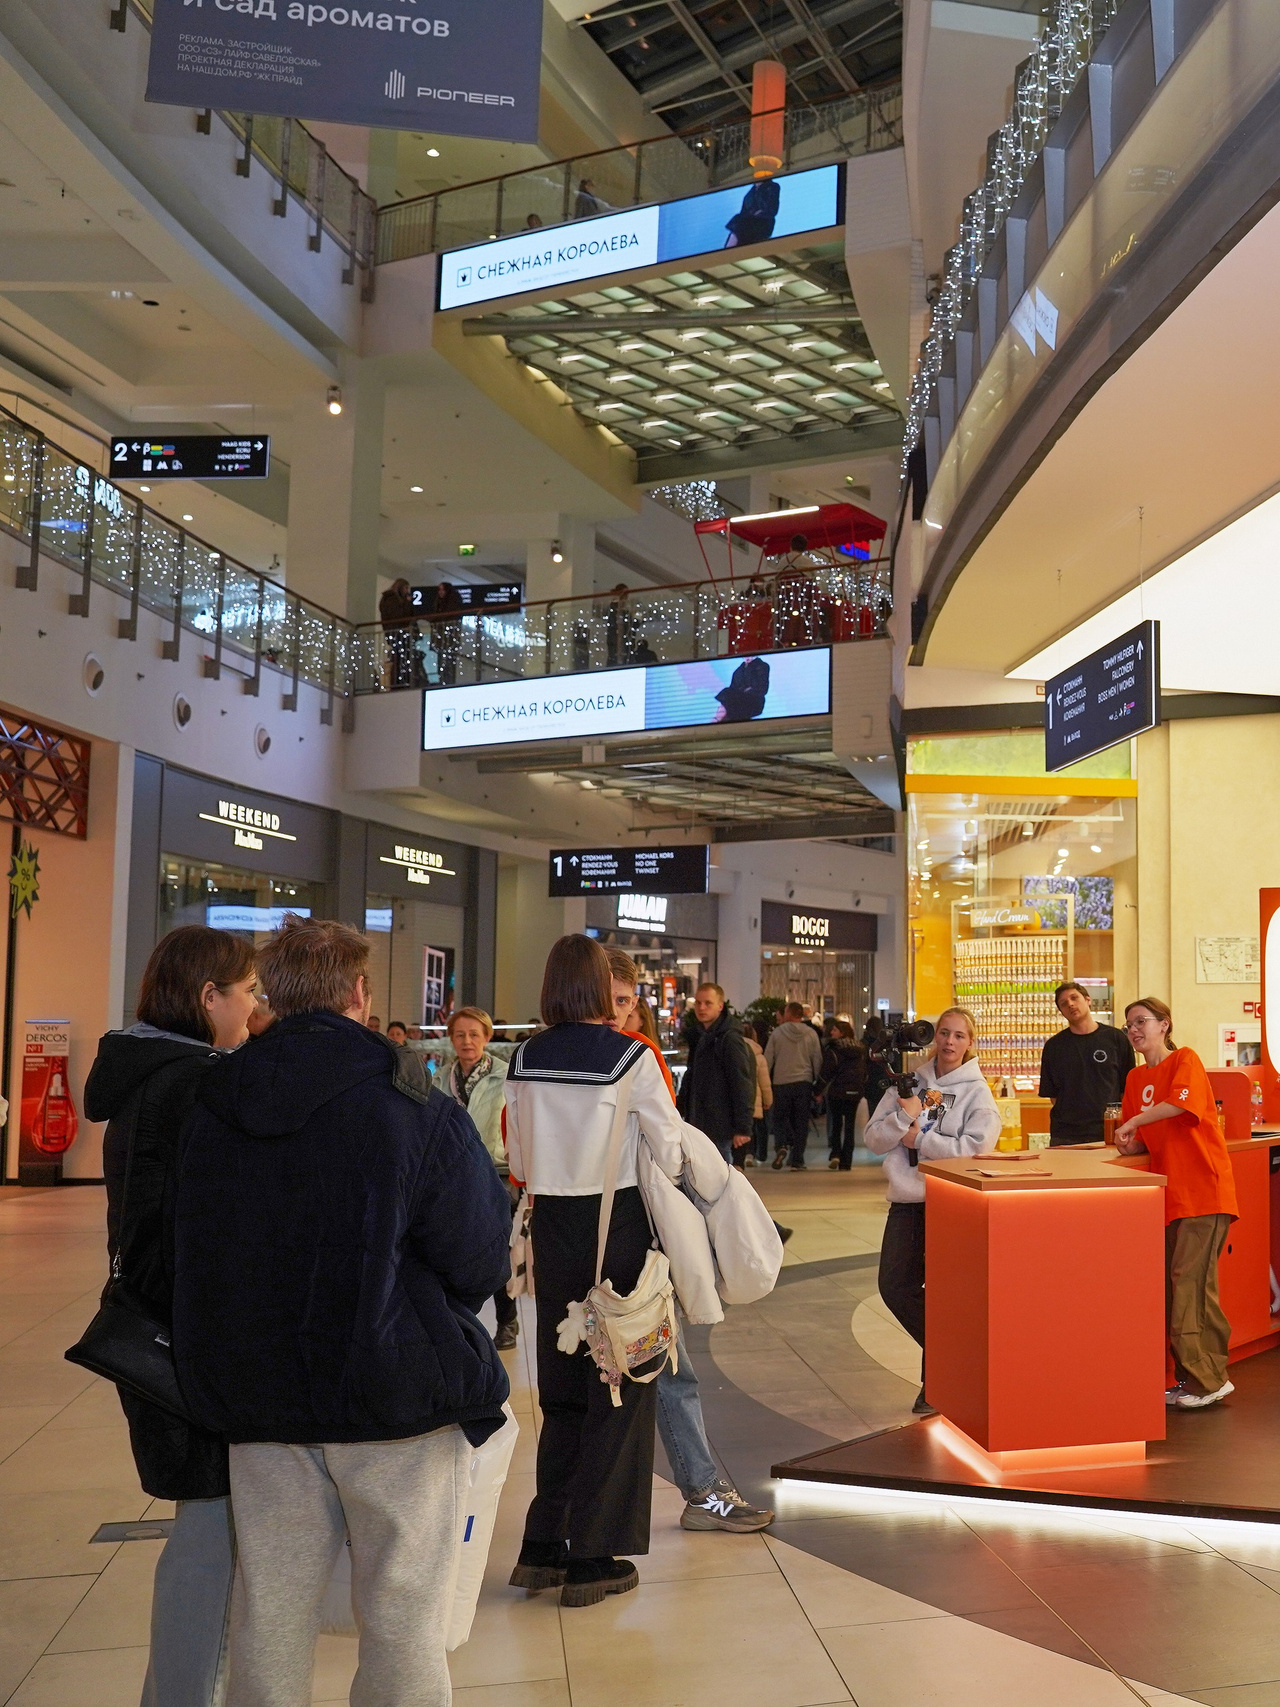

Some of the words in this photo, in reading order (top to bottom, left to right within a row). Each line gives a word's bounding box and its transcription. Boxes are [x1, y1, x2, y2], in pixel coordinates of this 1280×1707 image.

[215, 0, 277, 20] сад
[286, 2, 450, 37] ароматов
[178, 44, 200, 53] ООО
[223, 49, 251, 59] ЛАЙФ
[179, 34, 225, 46] РЕКЛАМА.
[227, 39, 292, 54] ЗАСТРОЙЩИК
[177, 53, 232, 67] ПРОЕКТНАЯ
[234, 61, 295, 74] ДЕКЛАРАЦИЯ
[177, 63, 190, 72] НА
[272, 74, 303, 86] ПРАЙД
[417, 87, 515, 107] PIONEER
[477, 251, 552, 280] СНЕЖНАЯ
[557, 233, 639, 262] КОРОЛЕВА
[114, 442, 128, 462] 2
[413, 590, 423, 606] 2
[462, 702, 537, 723] СНЕЖНАЯ
[543, 695, 626, 715] КОРОЛЕВА
[1047, 693, 1053, 729] 1
[219, 800, 280, 831] WEEKEND
[394, 845, 443, 868] WEEKEND
[553, 856, 563, 877] 1
[792, 915, 829, 937] BOGGI
[974, 910, 999, 926] Hand
[997, 909, 1029, 923] Cream
[26, 1034, 67, 1042] DERCOS
